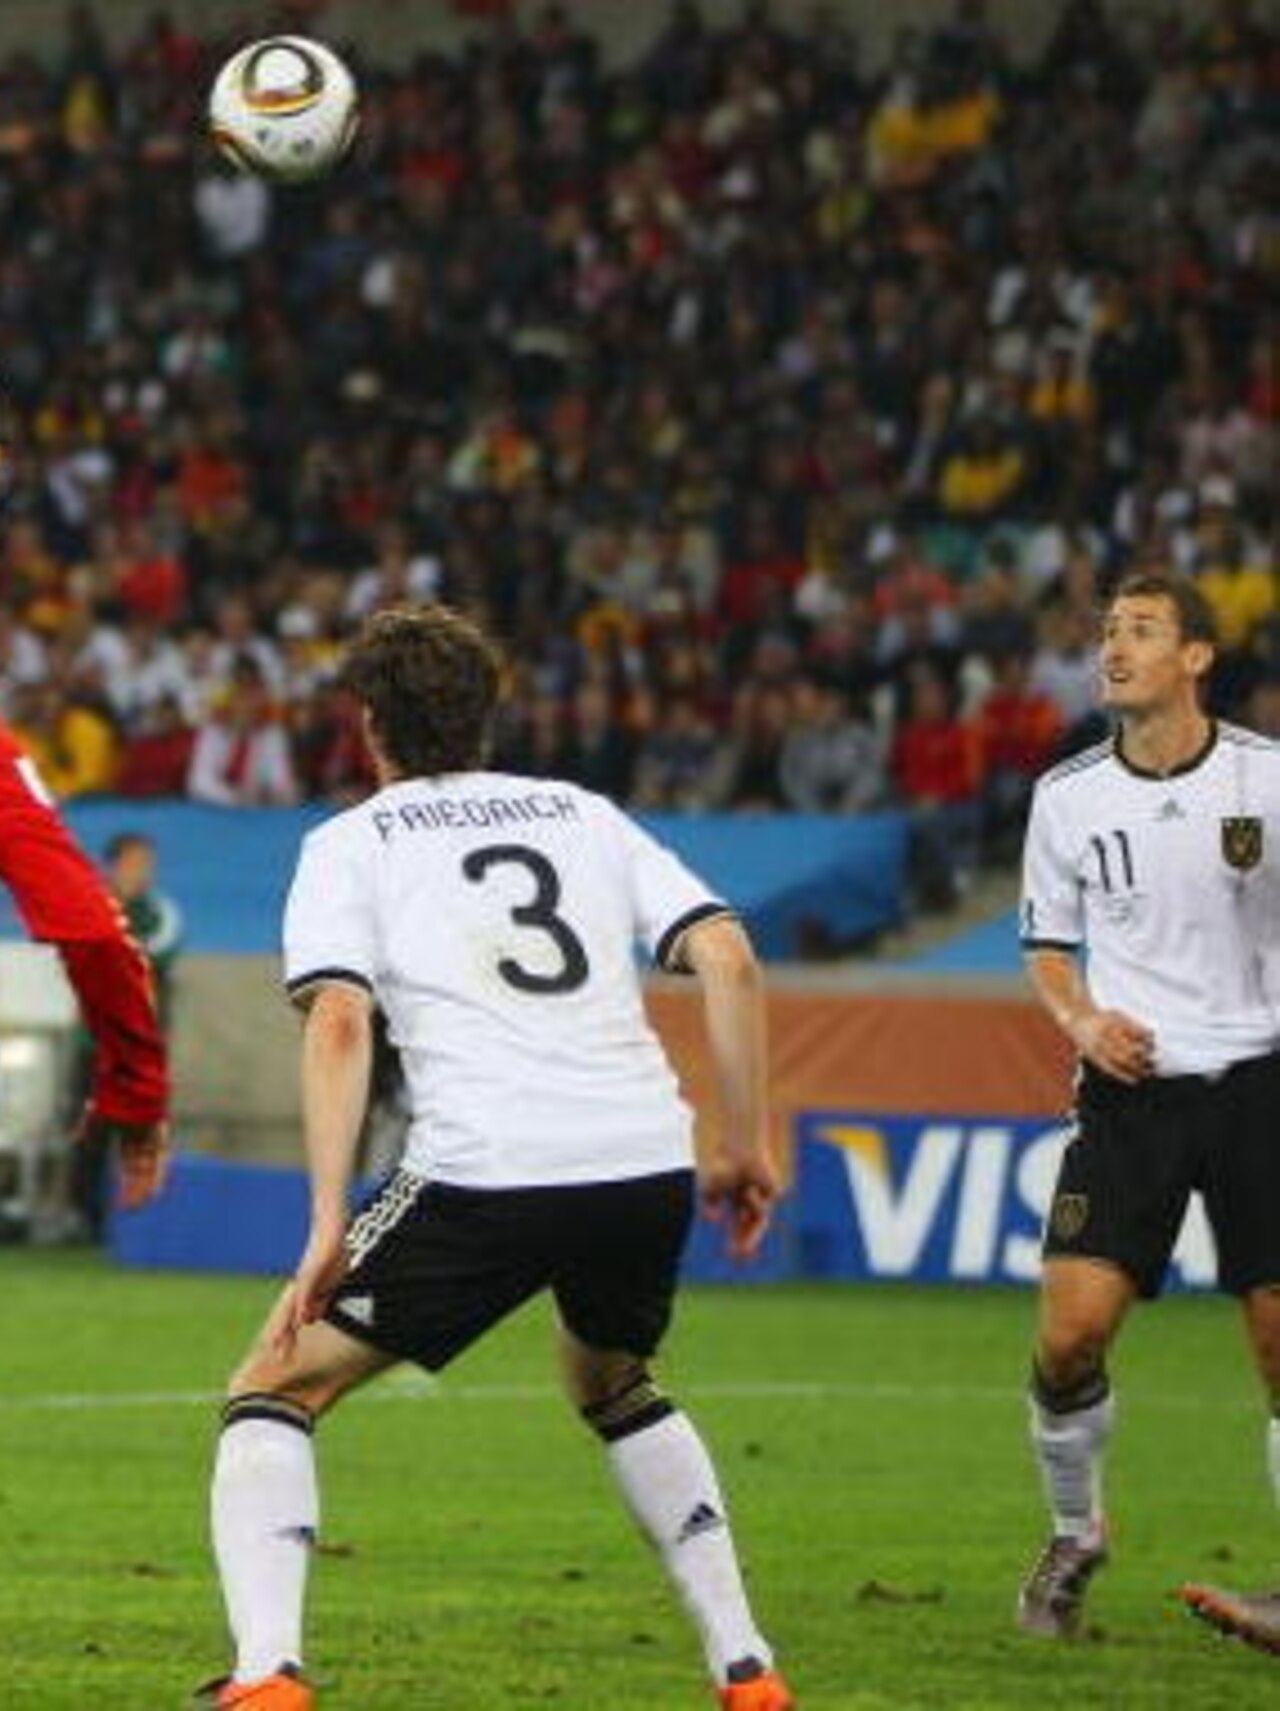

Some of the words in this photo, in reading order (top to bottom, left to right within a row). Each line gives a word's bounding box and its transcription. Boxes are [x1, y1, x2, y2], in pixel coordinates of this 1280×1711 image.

[372, 795, 580, 842] FRIEDRICH
[1091, 829, 1134, 893] 11
[462, 843, 590, 996] 3
[817, 1124, 1220, 1285] VIS
